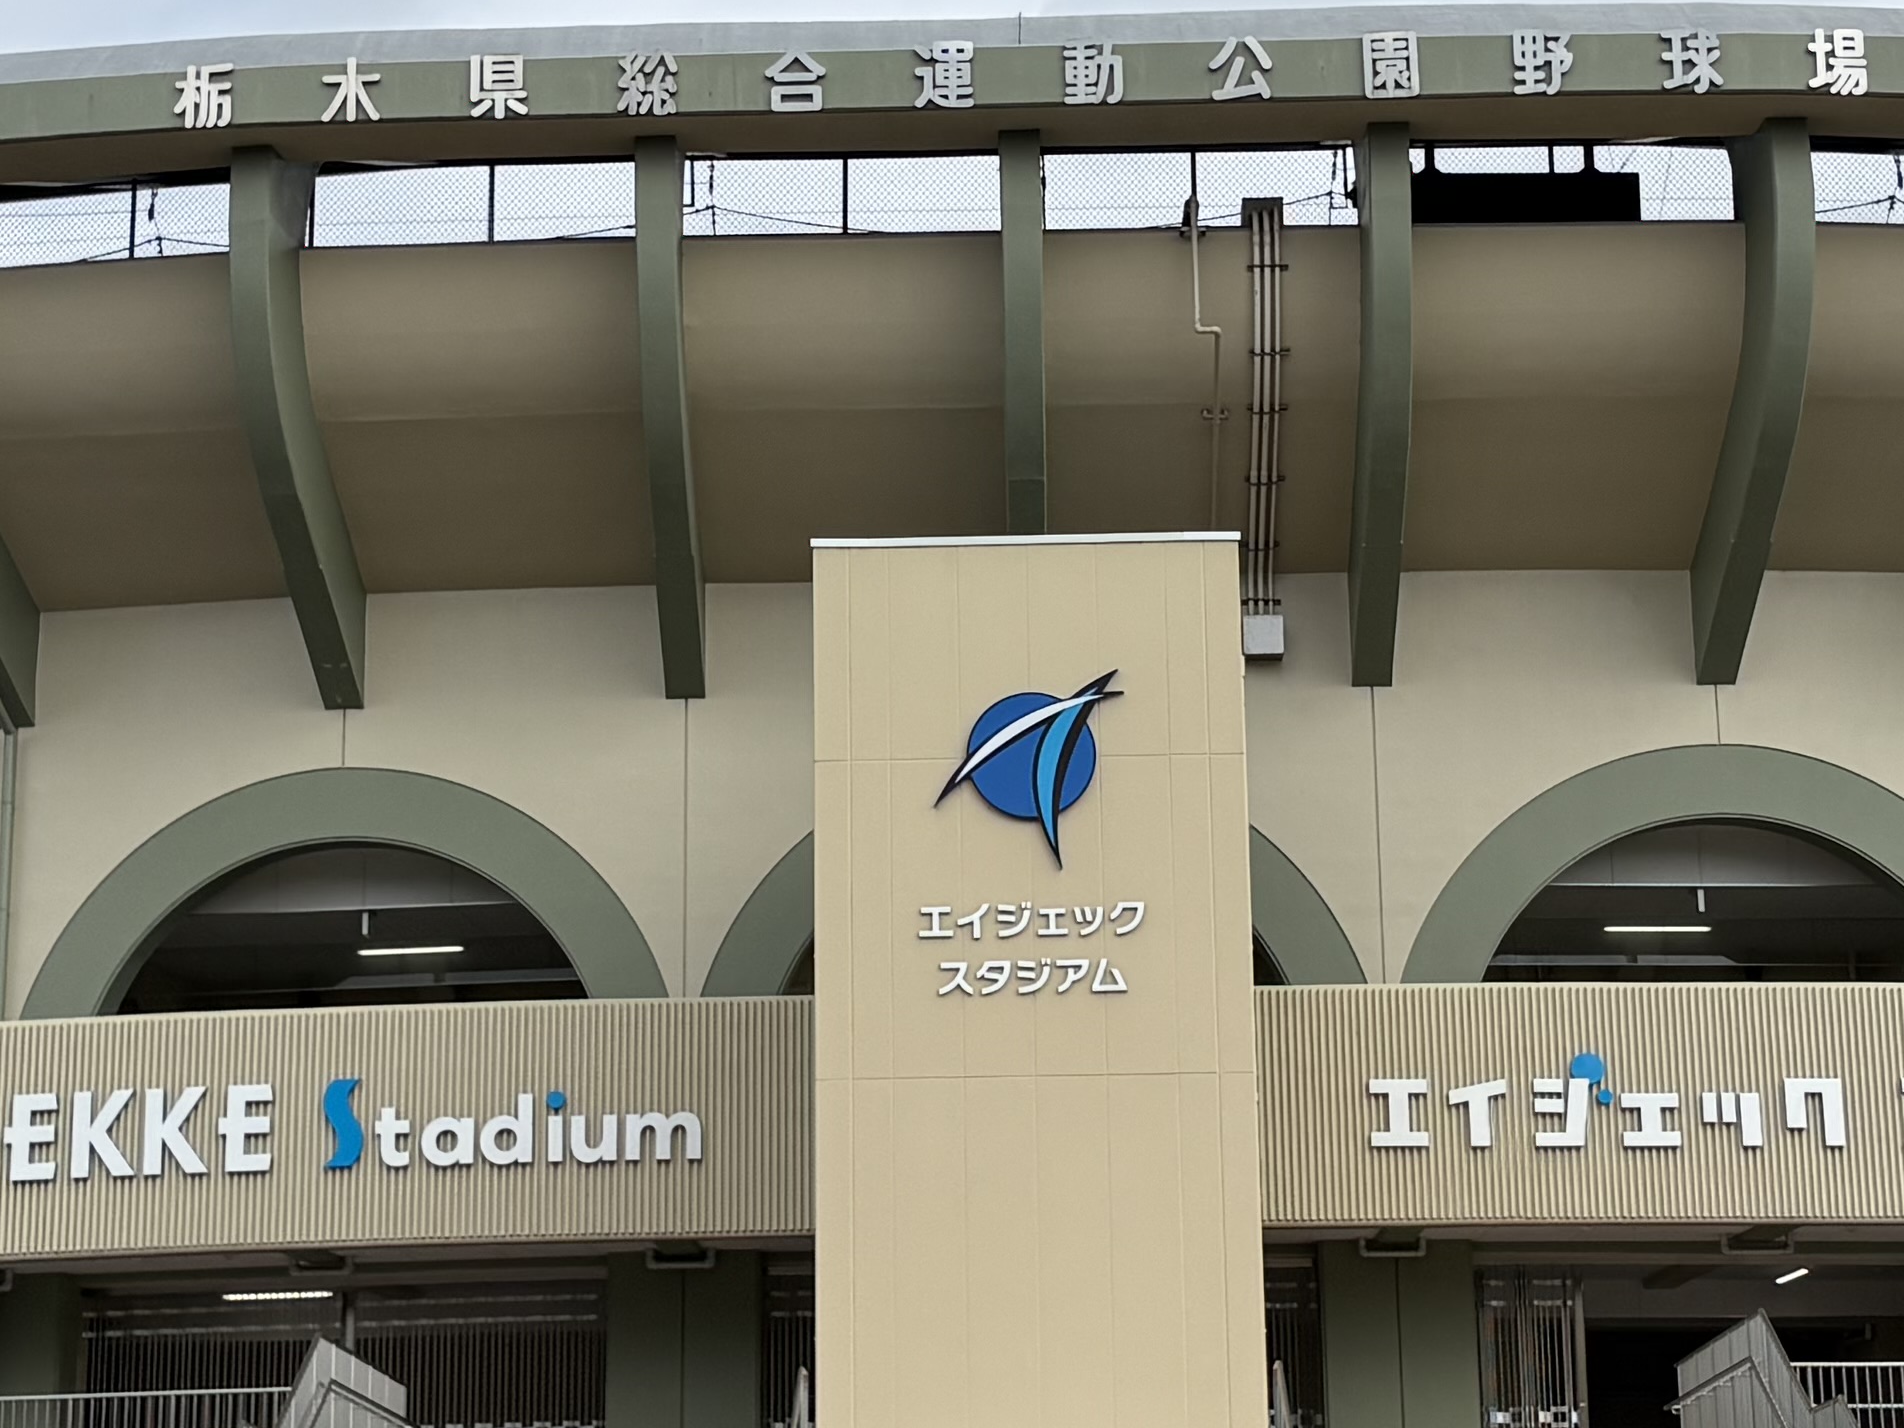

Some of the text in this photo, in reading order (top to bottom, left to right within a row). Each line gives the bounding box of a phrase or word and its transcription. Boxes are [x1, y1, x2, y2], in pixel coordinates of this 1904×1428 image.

[172, 27, 1870, 130] 栃木県総合運動公園野球場
[918, 901, 1145, 940] エイジェック
[938, 957, 1129, 996] スタジアム
[323, 1077, 704, 1172] Stadium
[1366, 1051, 1847, 1149] エイジェック
